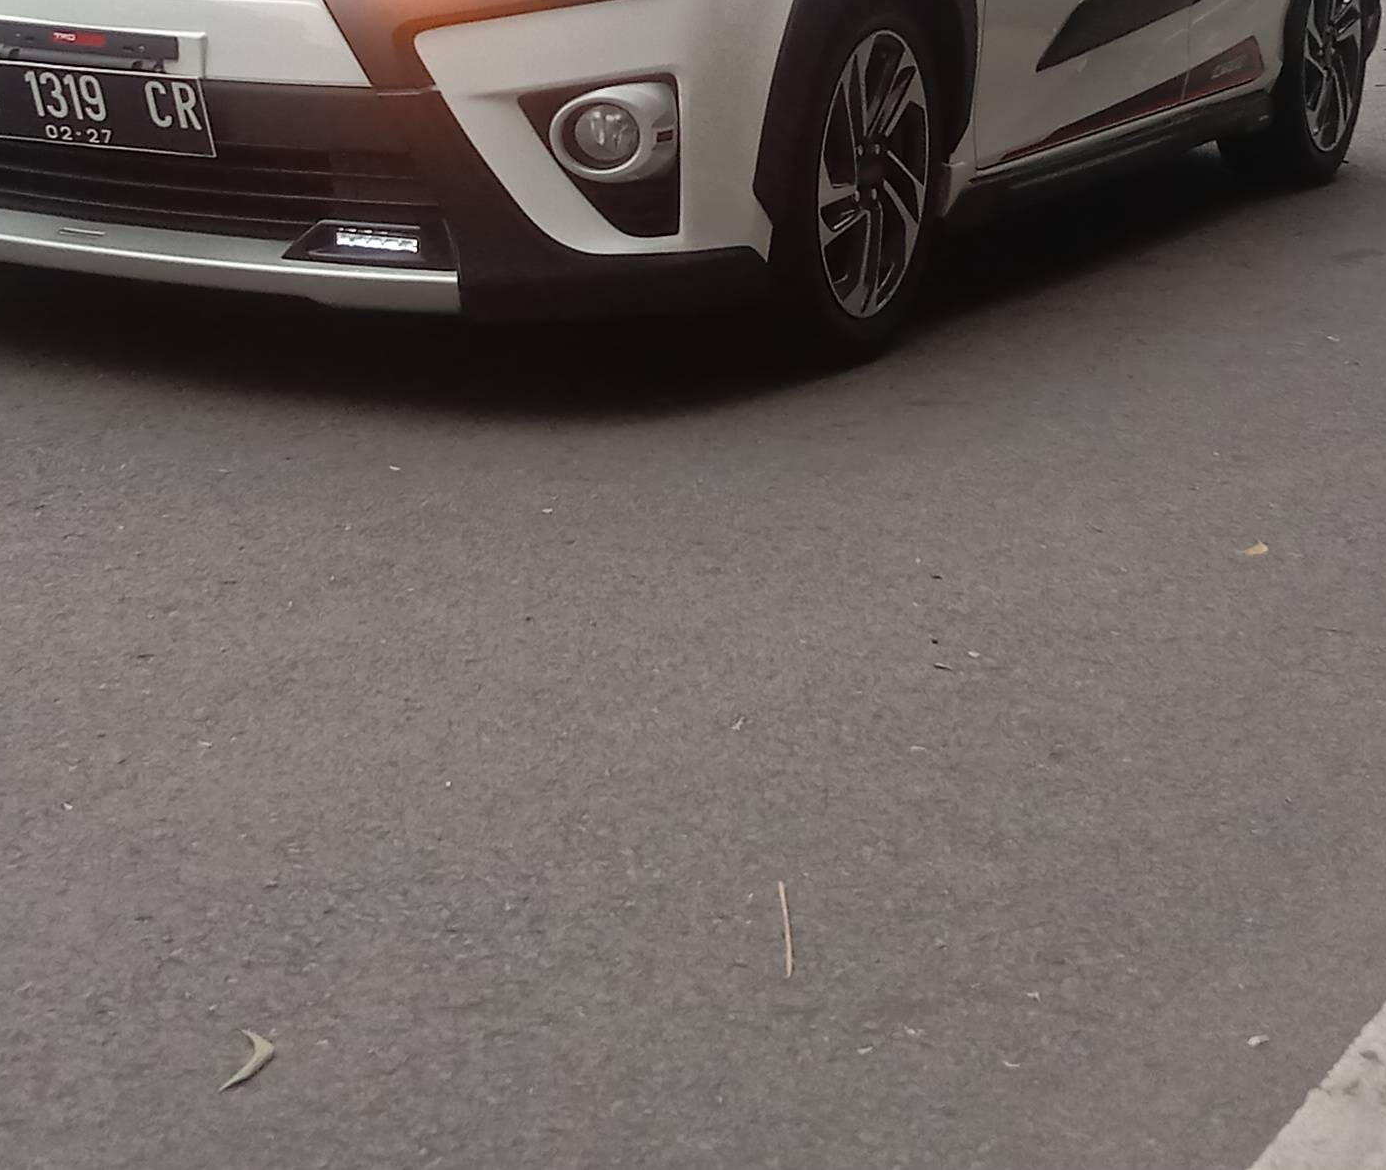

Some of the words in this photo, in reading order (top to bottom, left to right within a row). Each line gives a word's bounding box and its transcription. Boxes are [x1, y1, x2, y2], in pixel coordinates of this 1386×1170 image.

[53, 31, 77, 42] TRD
[24, 70, 107, 122] 1319
[144, 81, 203, 131] CR
